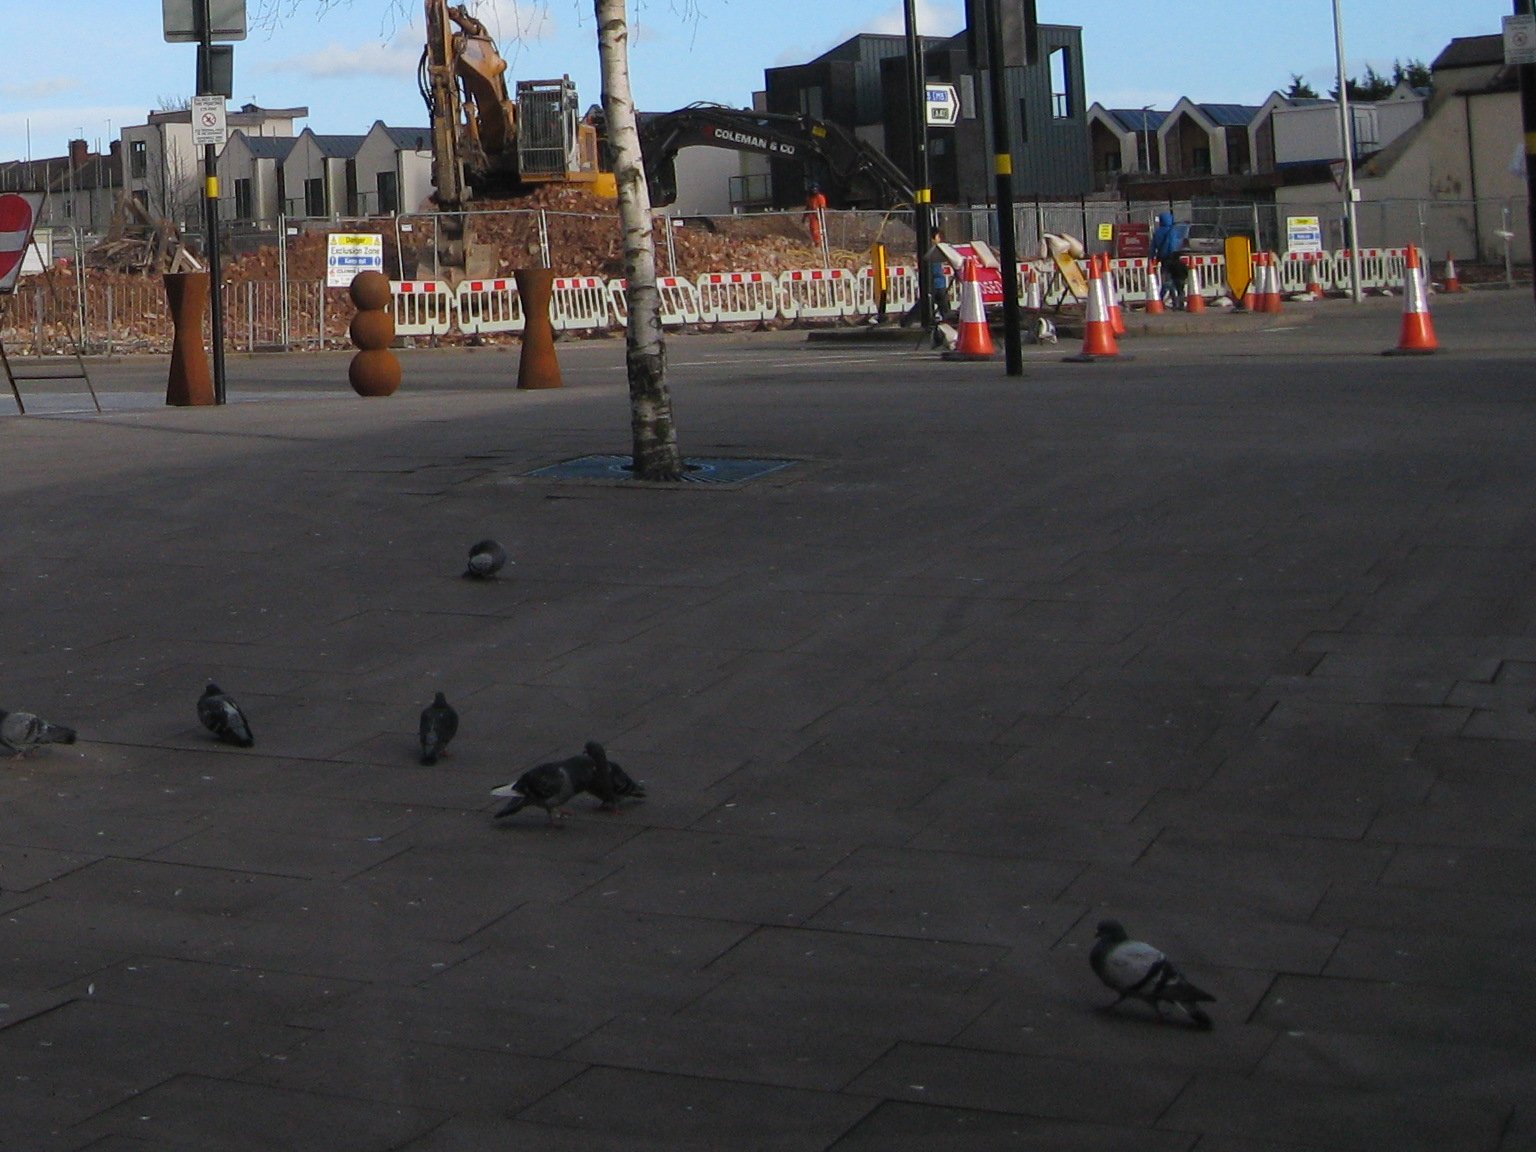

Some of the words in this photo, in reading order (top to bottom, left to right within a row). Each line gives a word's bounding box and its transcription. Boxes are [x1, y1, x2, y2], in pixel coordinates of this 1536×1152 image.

[714, 128, 768, 149] COLEMAN
[769, 141, 778, 151] &
[780, 144, 796, 155] CO
